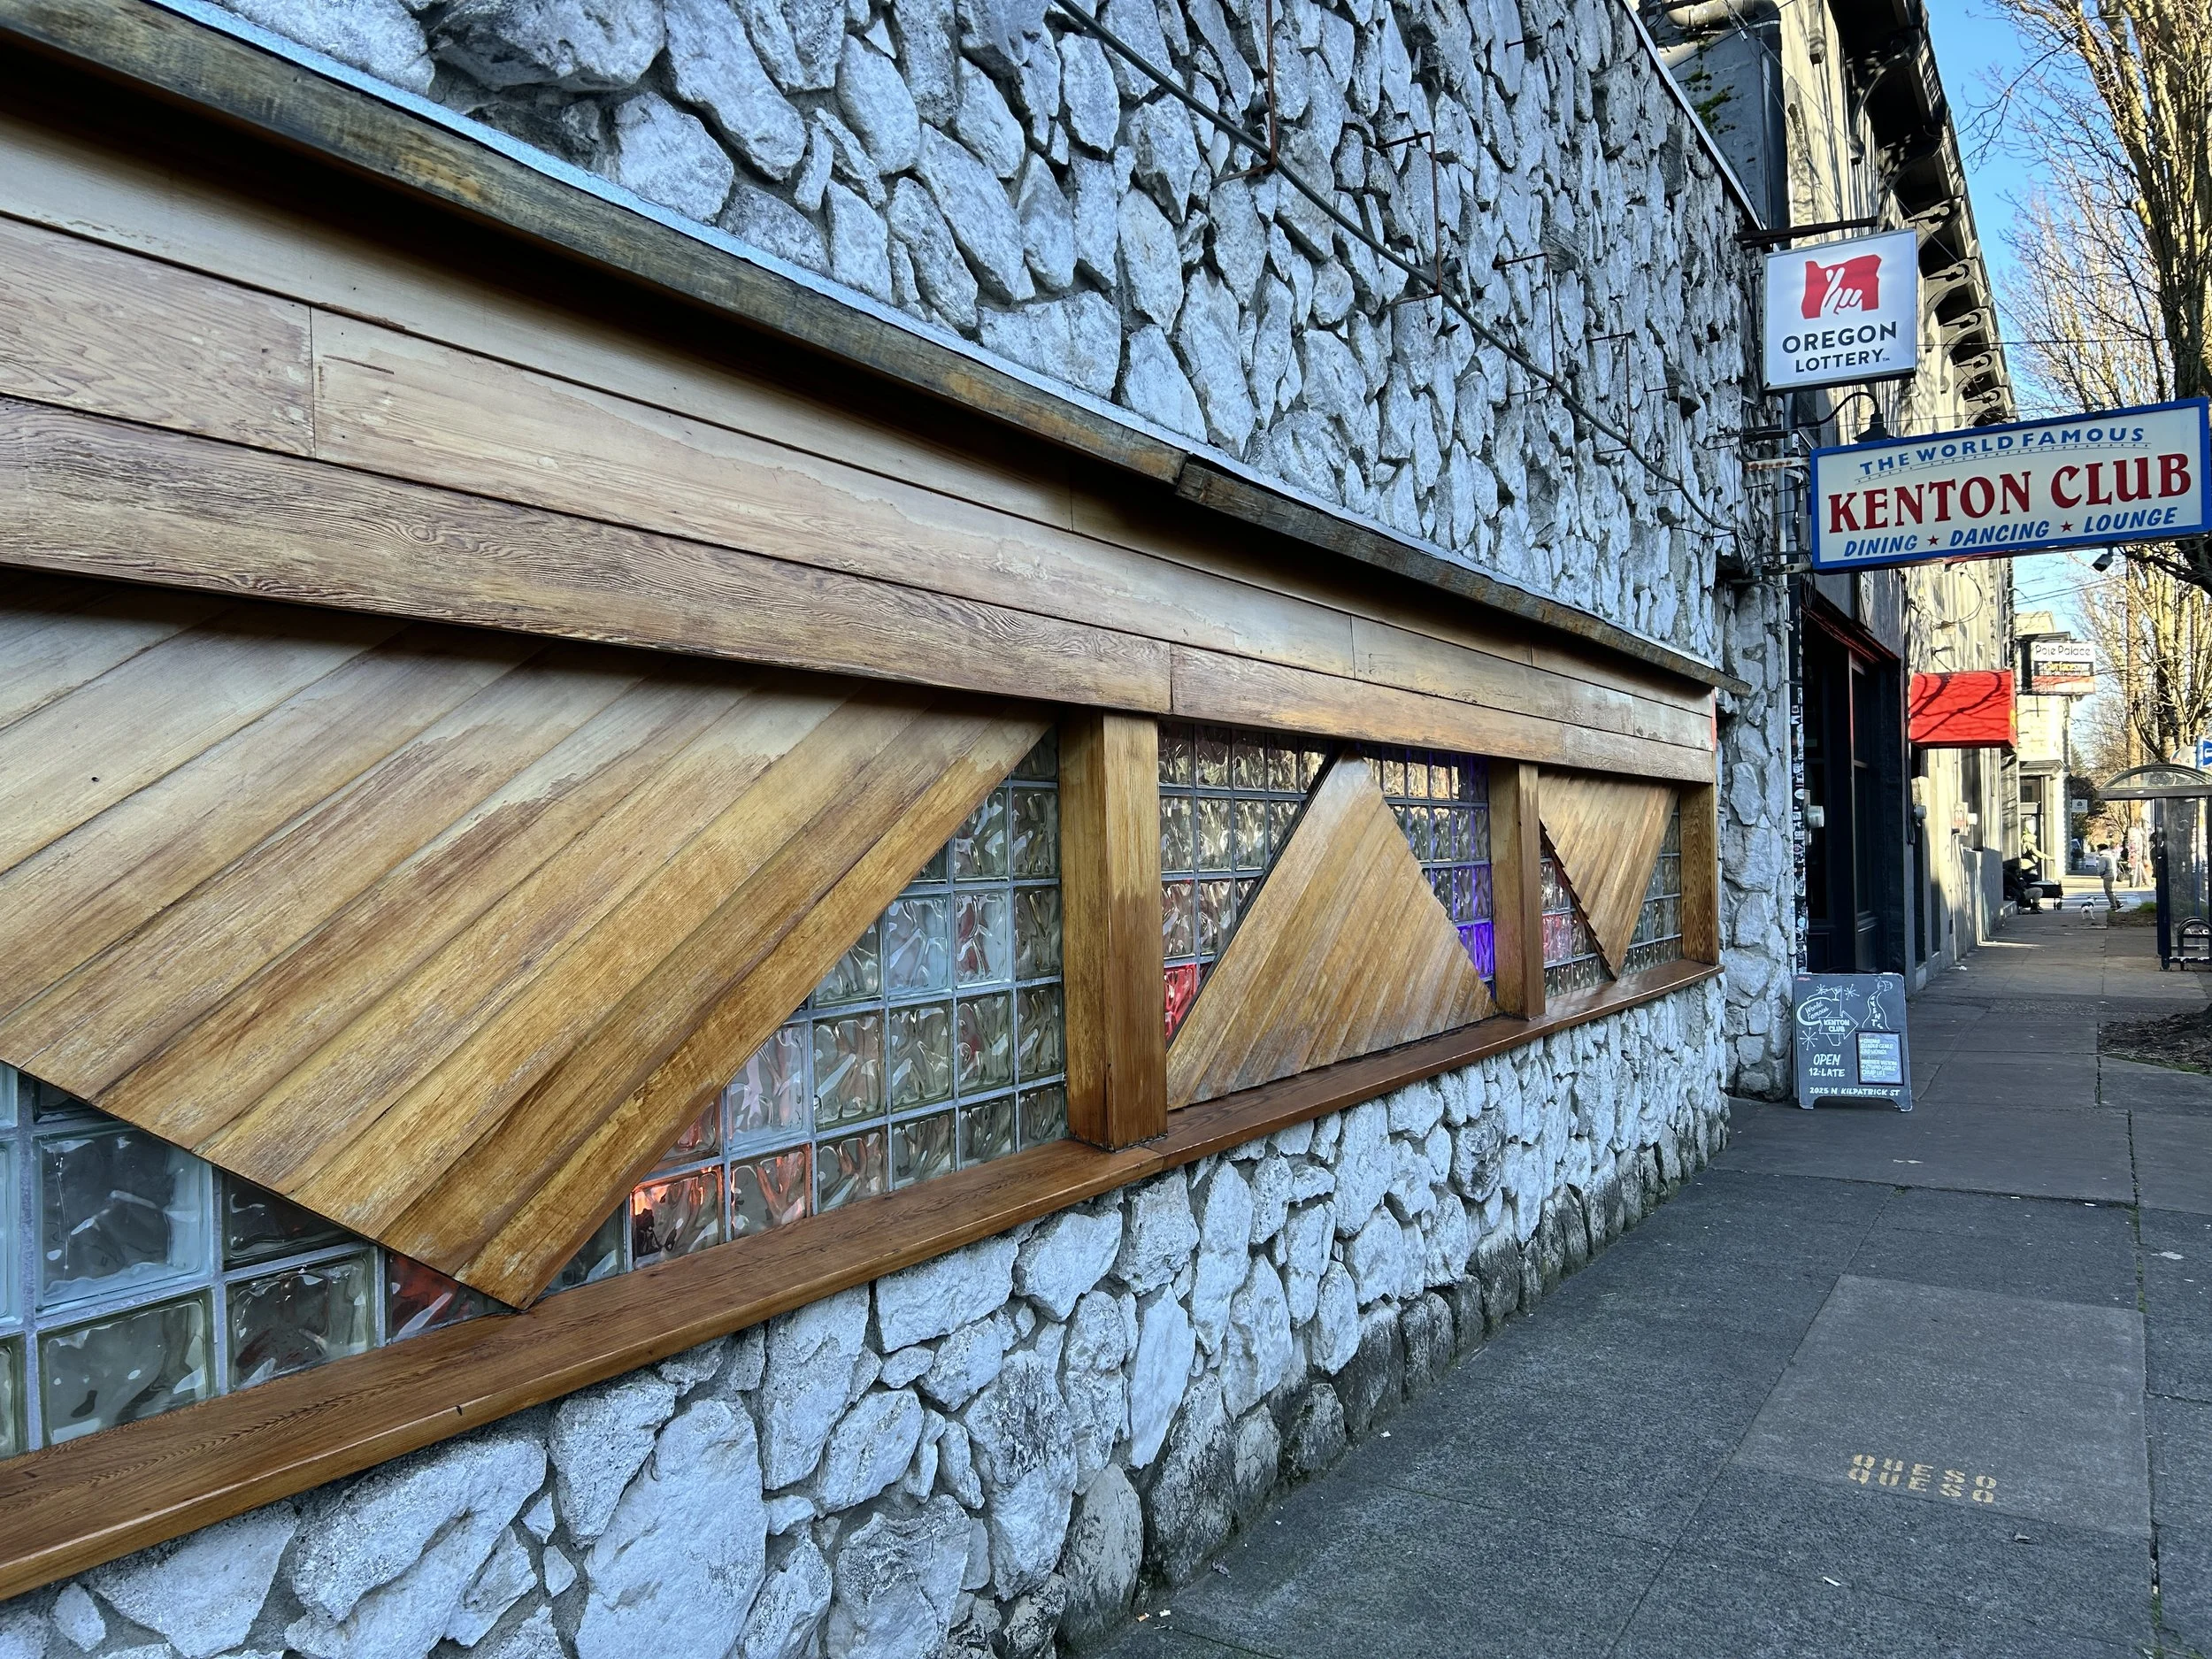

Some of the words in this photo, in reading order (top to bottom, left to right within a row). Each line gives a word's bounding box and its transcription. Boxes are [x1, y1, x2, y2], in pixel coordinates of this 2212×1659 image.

[1782, 321, 1897, 354] OREGON
[1795, 348, 1885, 373] LOTTERY
[1860, 452, 1910, 475] THE
[1916, 435, 2014, 462] WORLD
[2023, 427, 2144, 447] FAMOUS
[1828, 471, 2032, 534] KENTON
[2050, 453, 2192, 509] CLUB
[1844, 534, 1918, 557] DINING
[1949, 520, 2050, 546] DANCING
[2084, 506, 2178, 533] LOUNGE
[2035, 644, 2056, 656] Pole
[2057, 645, 2091, 656] Palace
[1804, 1000, 1824, 1015] World
[1813, 1053, 1841, 1065] OPEN
[1809, 1067, 1846, 1078] 12-LATE
[1840, 1087, 1887, 1095] KILPATRICK
